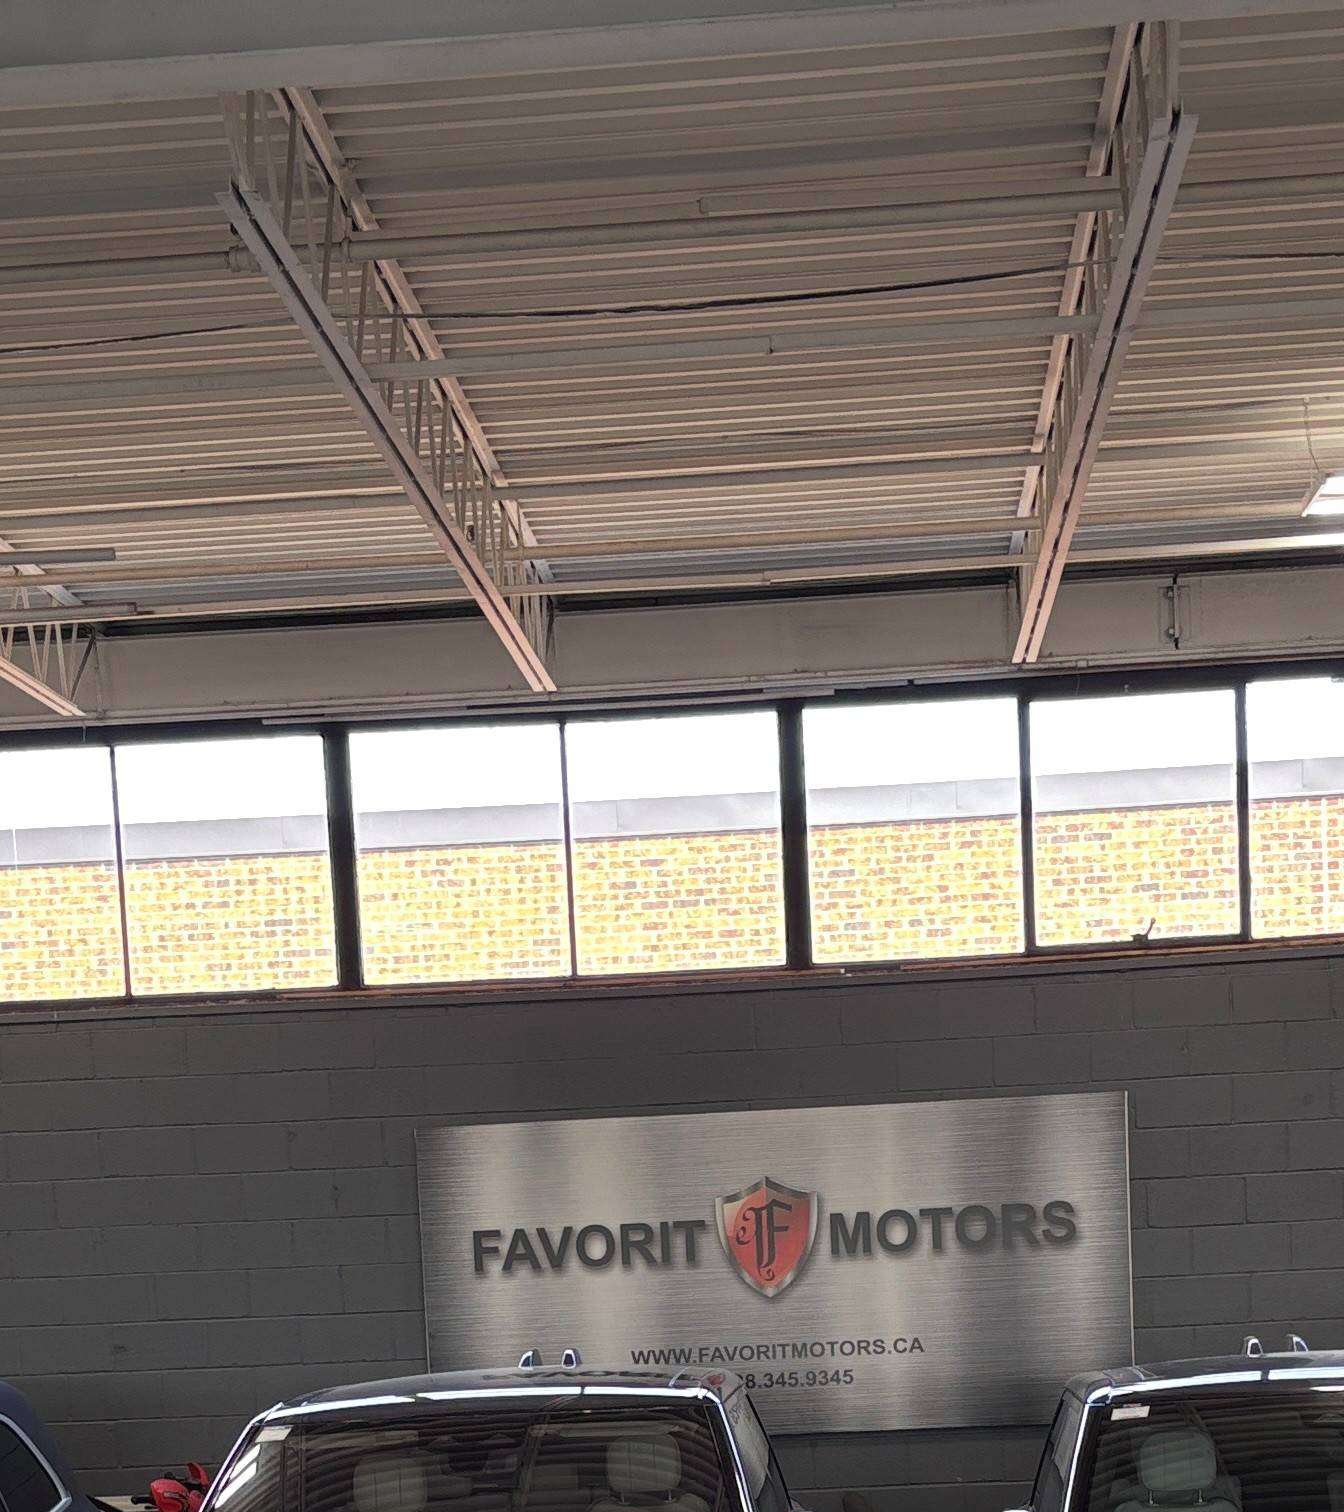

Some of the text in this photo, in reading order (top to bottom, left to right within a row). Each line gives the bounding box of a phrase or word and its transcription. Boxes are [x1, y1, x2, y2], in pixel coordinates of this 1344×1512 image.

[472, 1219, 706, 1272] FAVORIT
[830, 1199, 1078, 1255] MOTORS
[631, 1337, 926, 1365] WWW.FAVORITMOTORS.CA
[737, 1369, 854, 1390] 8.345.9345
